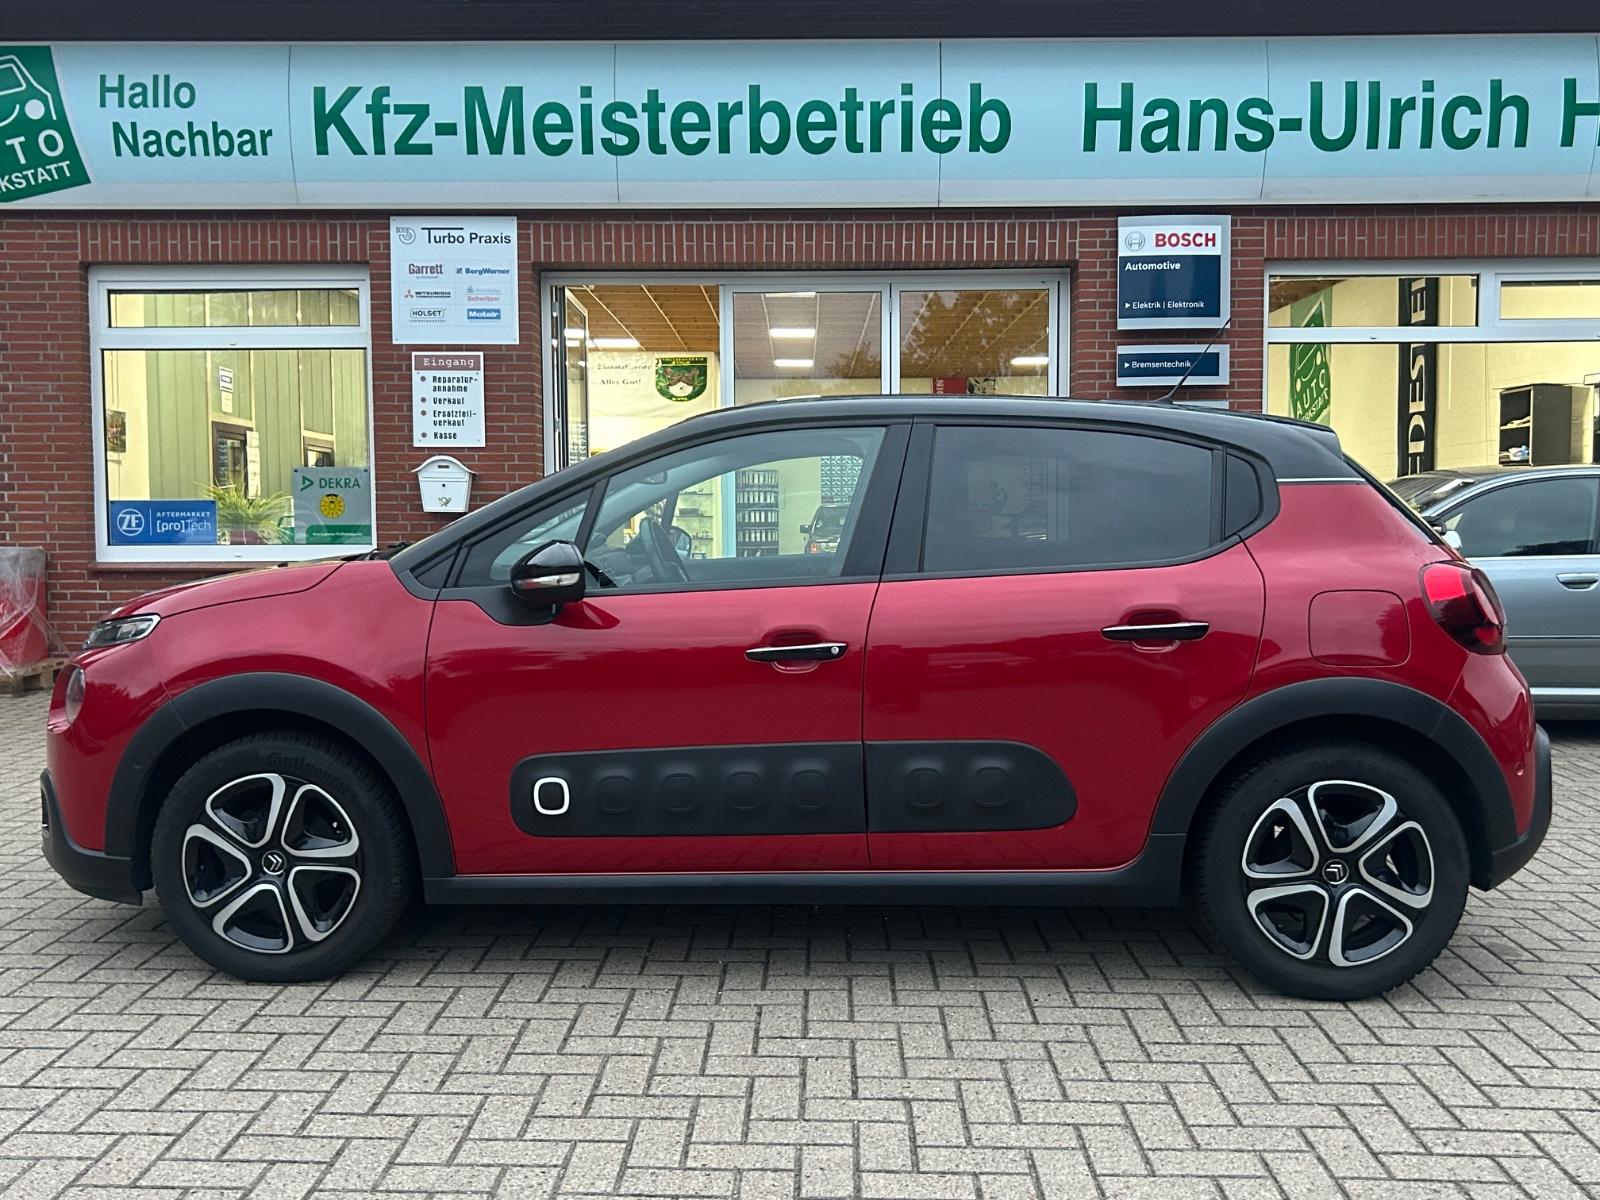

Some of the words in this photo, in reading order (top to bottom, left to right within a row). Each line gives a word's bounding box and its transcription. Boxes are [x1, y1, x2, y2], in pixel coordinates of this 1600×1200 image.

[99, 74, 196, 109] Hallo
[313, 83, 1010, 156] Kfz-Meisterbetrieb
[1082, 79, 1529, 153] Hans-Ulrich
[112, 121, 273, 158] Nachbar
[0, 160, 71, 193] KSTATT
[421, 227, 465, 244] Turbo
[469, 232, 511, 244] Praxis
[1155, 232, 1216, 248] BOSCH
[408, 263, 443, 275] Garrett
[465, 267, 510, 276] BorgWarner
[1125, 260, 1181, 271] Automotive
[1132, 301, 1161, 310] Elektrik
[1167, 300, 1205, 309] Elektronik
[423, 357, 474, 368] Eingang
[1132, 360, 1191, 369] Bremsentechnik
[432, 375, 478, 383] Reparatur-
[1296, 369, 1325, 418] AUTO
[433, 397, 465, 405] Verkauf
[433, 410, 477, 418] Ersatzteil-
[319, 477, 361, 489] DEKRA
[119, 513, 142, 530] ZF
[156, 520, 211, 534] [pro]Tech
